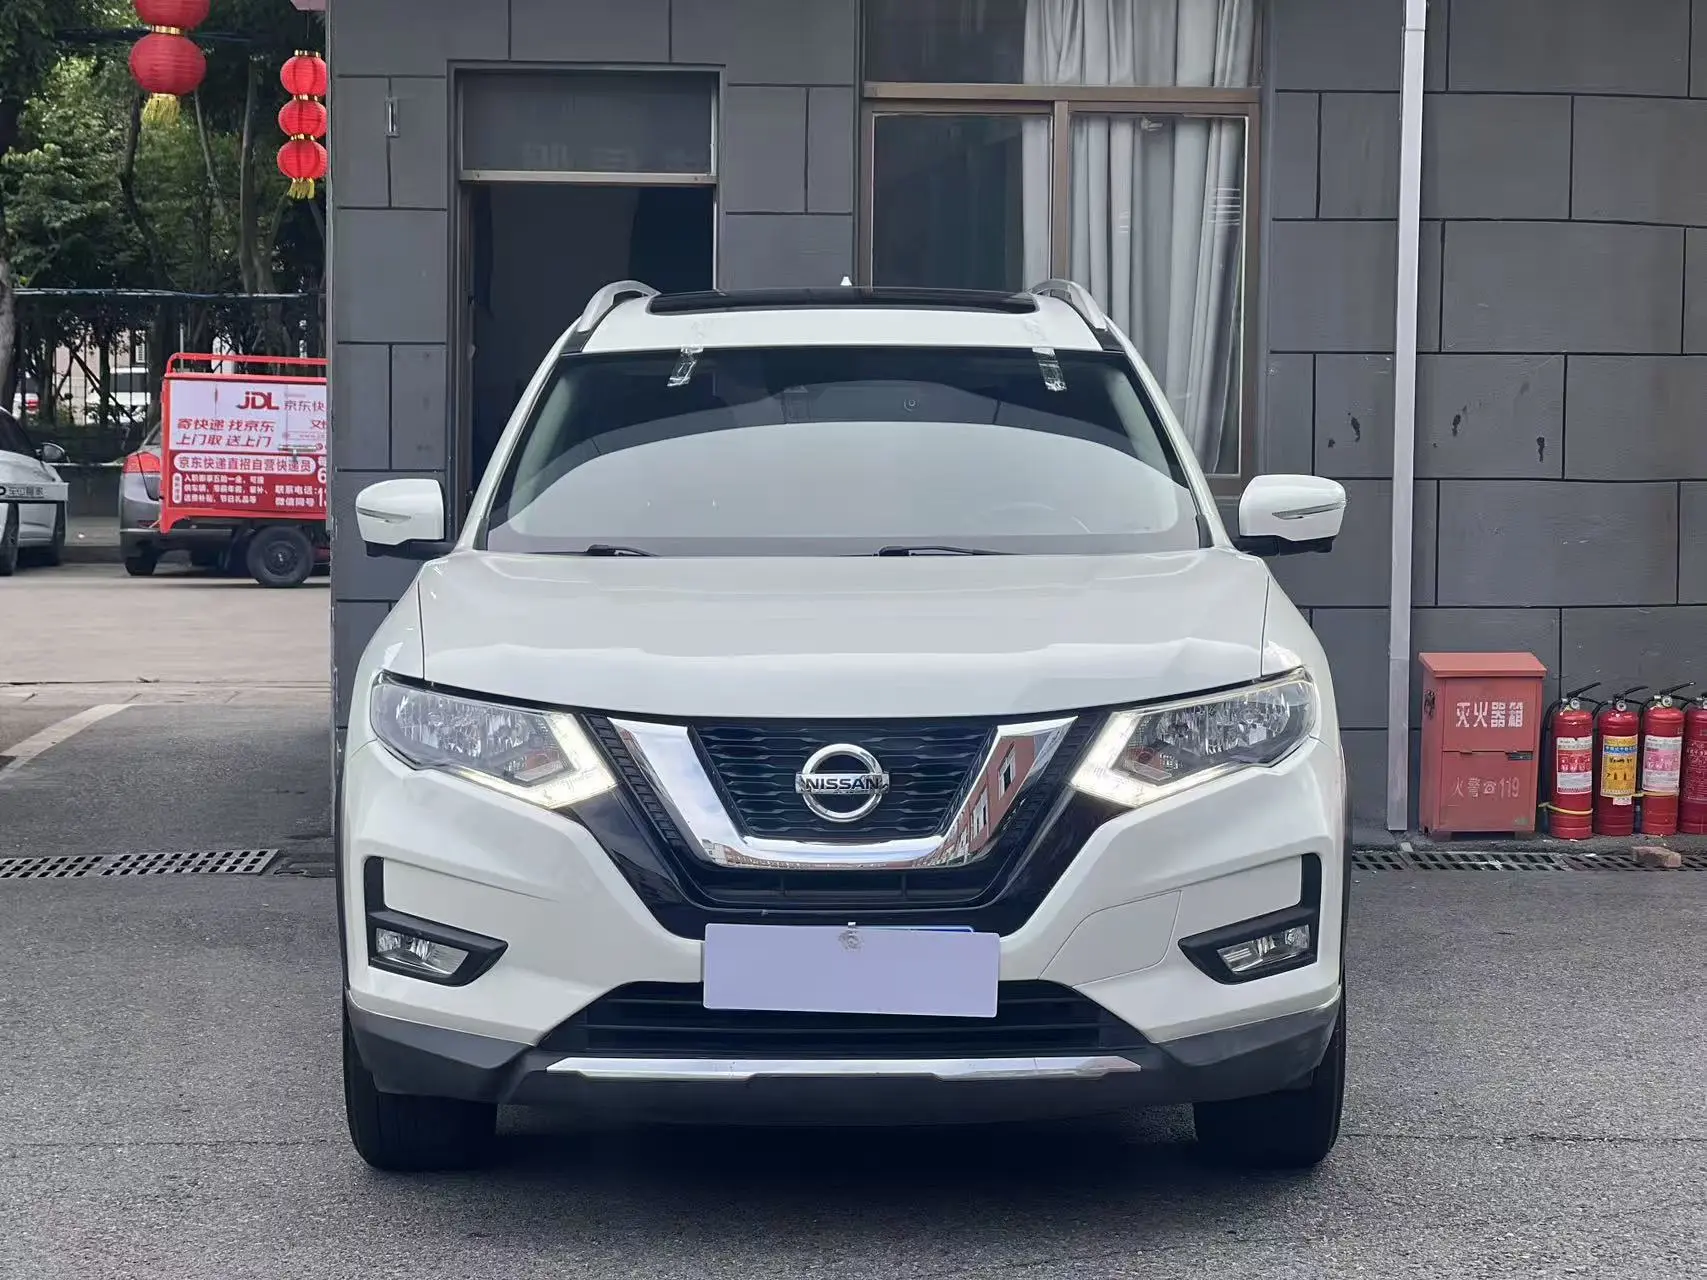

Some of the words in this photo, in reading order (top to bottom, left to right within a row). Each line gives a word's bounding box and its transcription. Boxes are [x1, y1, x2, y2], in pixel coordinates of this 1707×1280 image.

[236, 391, 279, 410] JDL
[177, 418, 225, 431] 寄快递
[228, 420, 276, 432] 找京东
[176, 433, 222, 446] 上门取
[226, 435, 272, 448] 送上门
[179, 456, 311, 473] 京东快递直招自营快递员
[1455, 702, 1524, 728] 灭火器箱
[806, 778, 879, 790] NISSAN
[1499, 778, 1520, 799] 119
